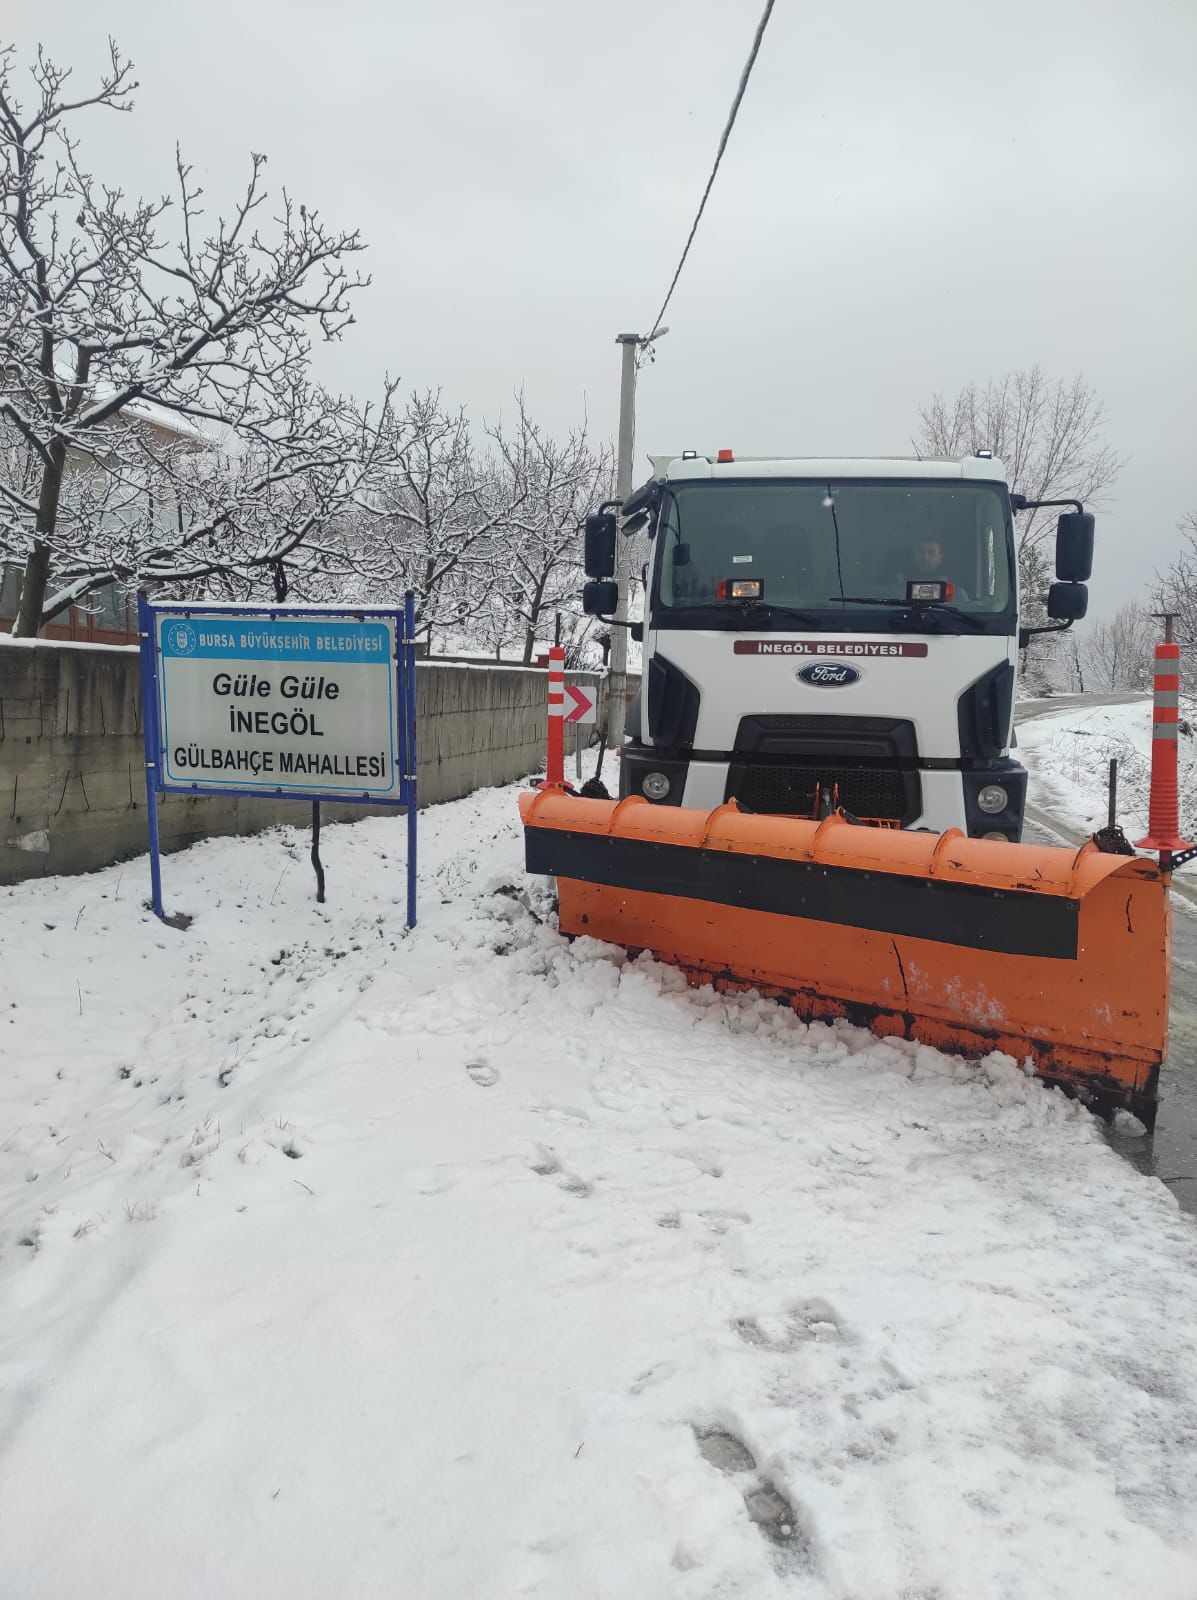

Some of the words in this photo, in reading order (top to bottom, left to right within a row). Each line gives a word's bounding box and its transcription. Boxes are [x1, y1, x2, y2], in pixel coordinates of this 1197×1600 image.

[199, 633, 236, 648] BURSA
[240, 632, 311, 652] BÜYÜKŞEHİR
[316, 634, 383, 652] BELEDİYESİ
[757, 642, 812, 654] İNEGÖL
[816, 644, 903, 656] BELEDİYESİ
[811, 666, 847, 682] Ford
[212, 673, 271, 698] Güle
[280, 675, 340, 700] Güle
[229, 705, 324, 736] İNEGÖL
[174, 743, 274, 776] GÜLBAHÇE
[279, 751, 386, 777] MAHALLESİ
